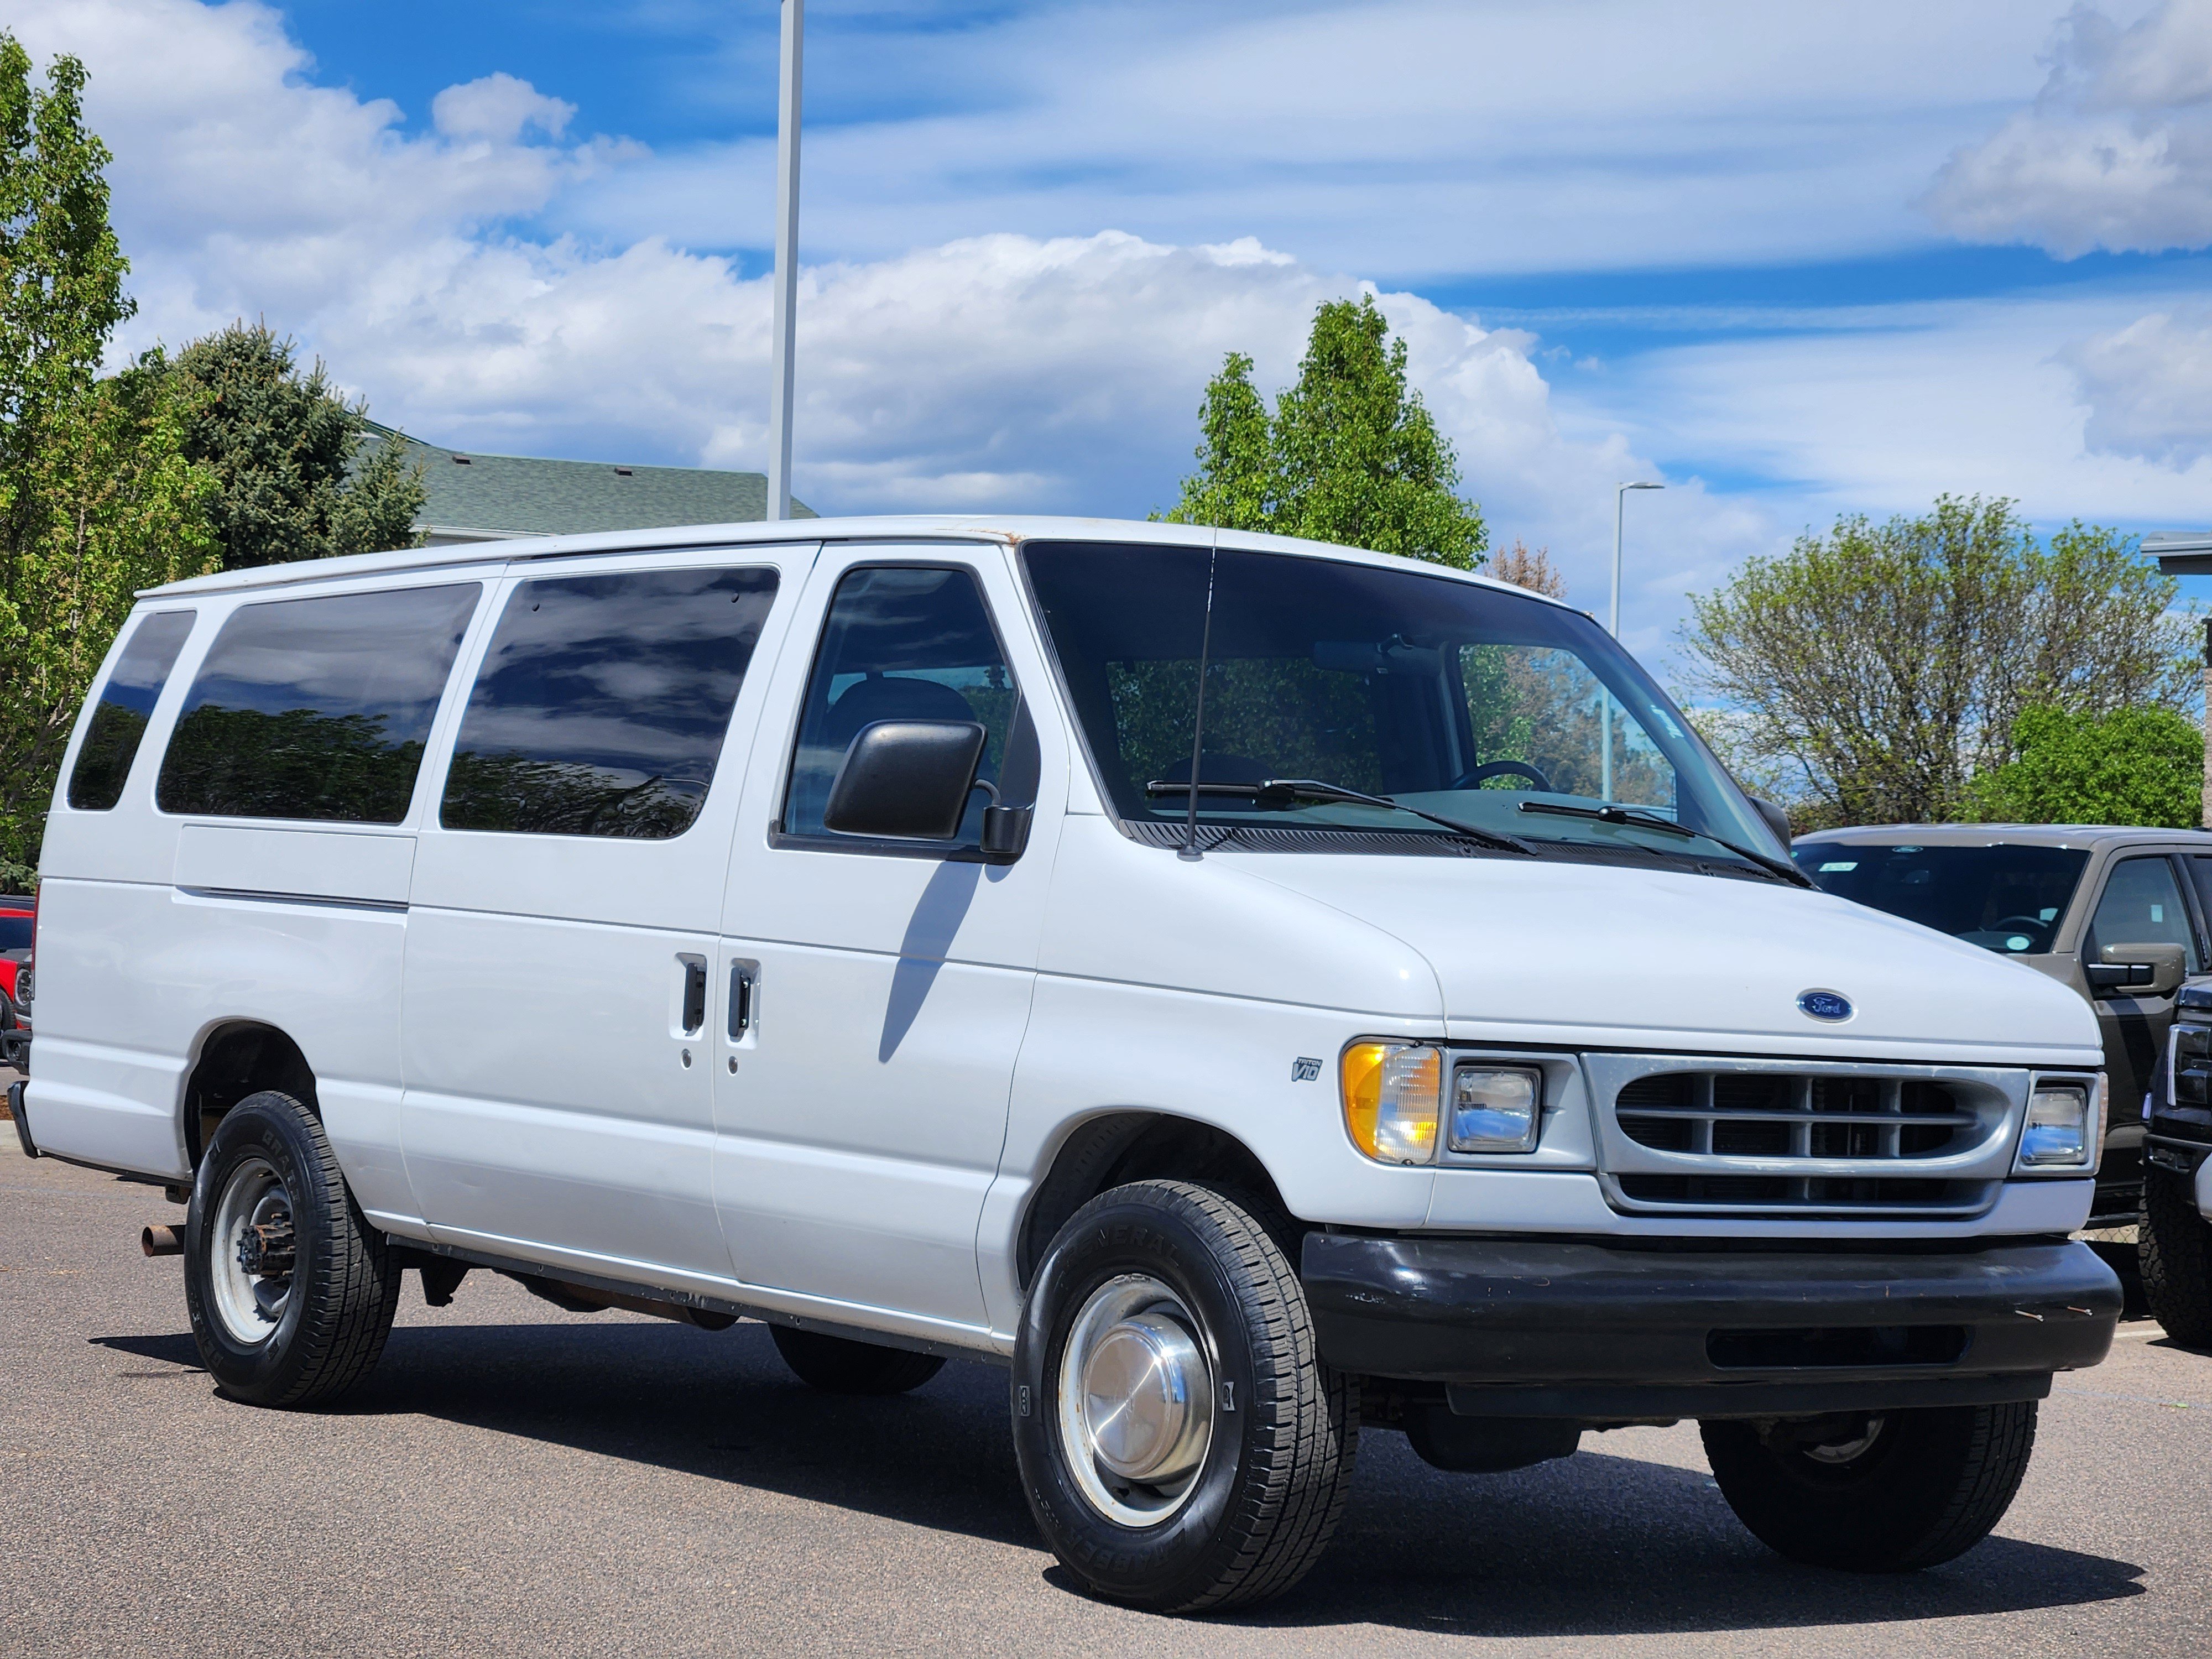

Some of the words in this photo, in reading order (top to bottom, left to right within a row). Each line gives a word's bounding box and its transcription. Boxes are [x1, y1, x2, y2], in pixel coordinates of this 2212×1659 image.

[1812, 997, 1841, 1014] Ford
[1297, 1058, 1322, 1067] TRITON
[1293, 1063, 1319, 1080] V10
